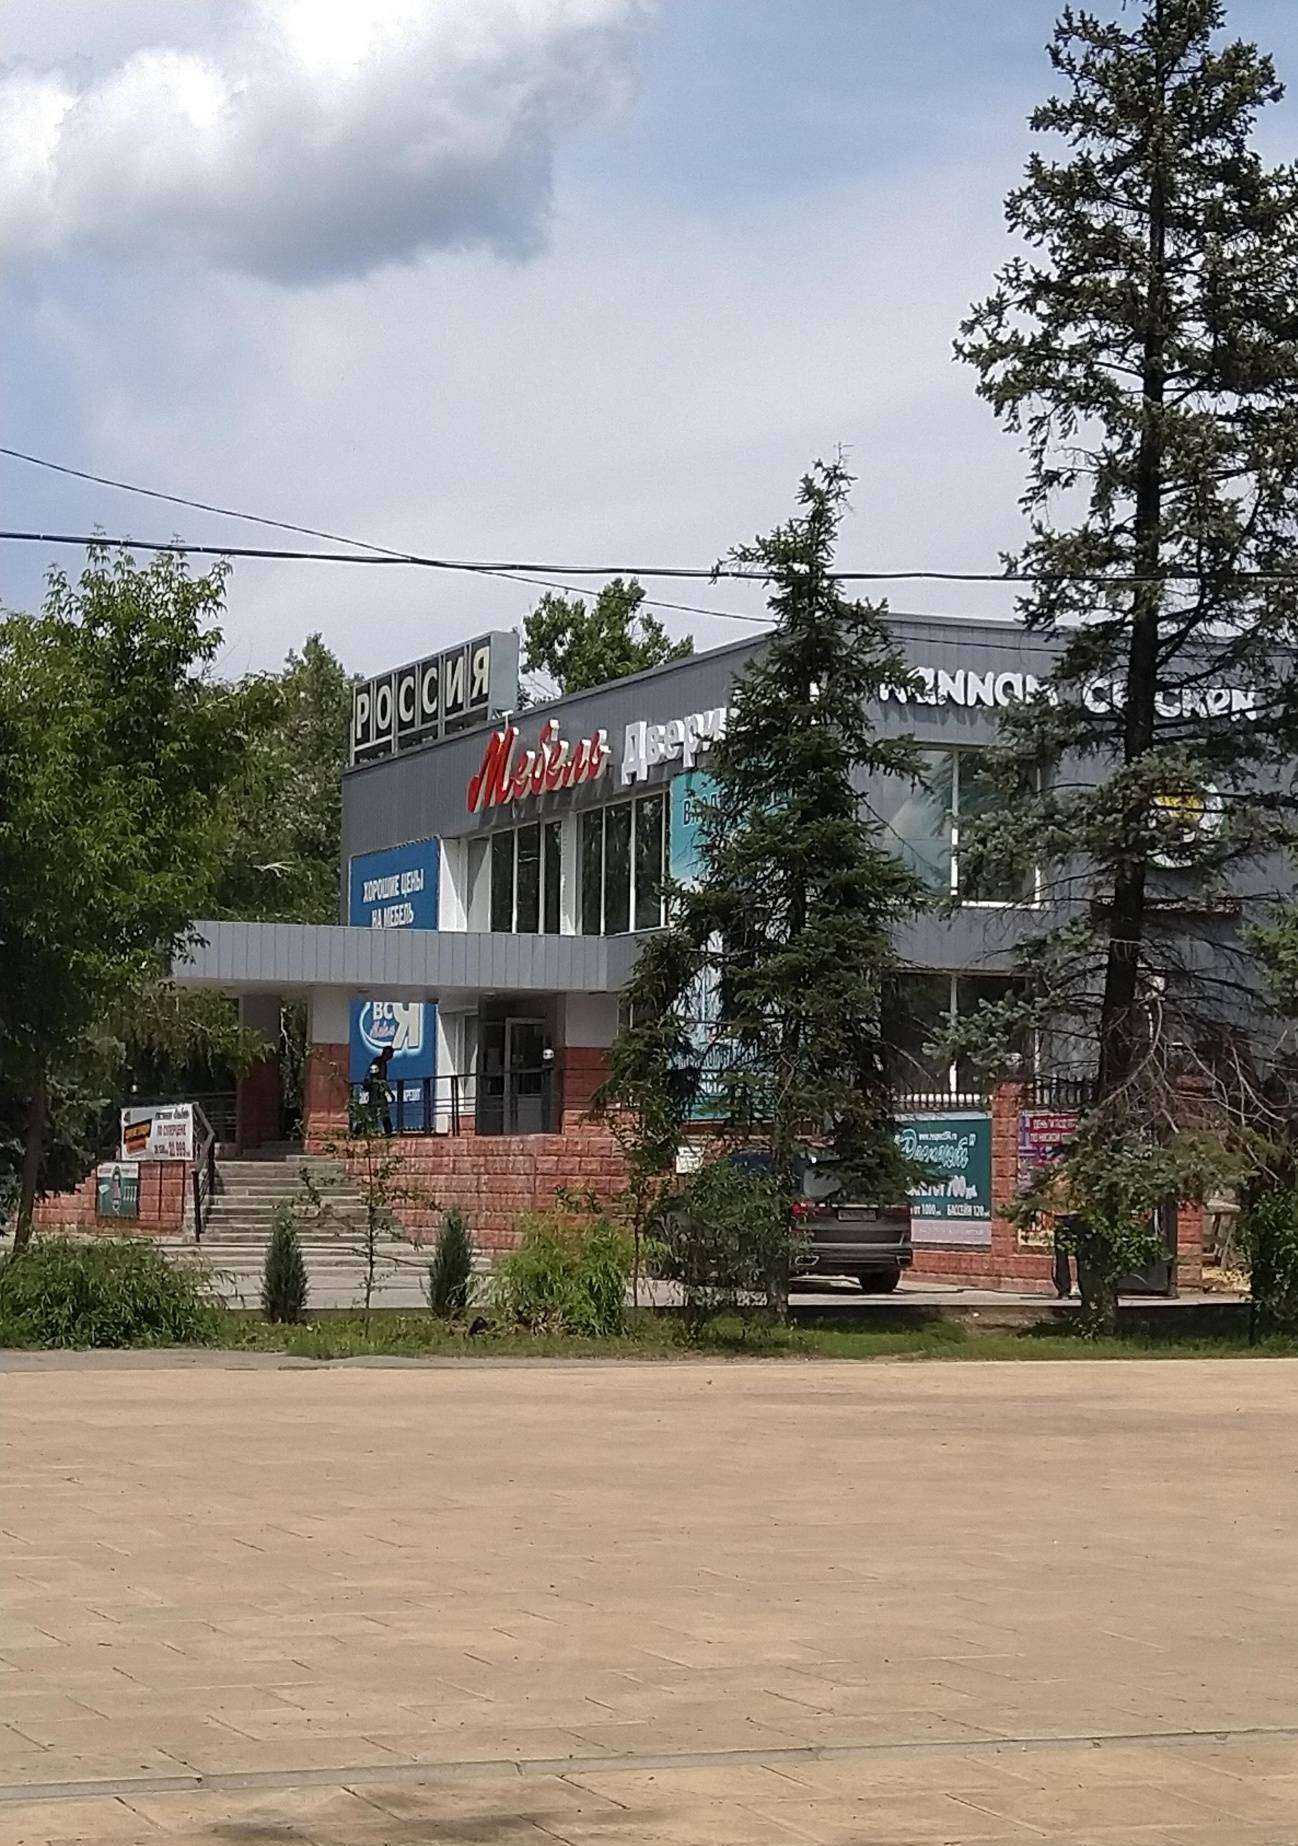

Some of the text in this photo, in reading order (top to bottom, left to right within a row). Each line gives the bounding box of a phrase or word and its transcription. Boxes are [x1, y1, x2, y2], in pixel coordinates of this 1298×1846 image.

[356, 645, 490, 740] РОССИЯ
[466, 719, 612, 813] Мебель
[363, 868, 424, 903] ХОРОШИЕ ЦЕНЫ
[371, 902, 414, 929] НА МЕБЕЛЬ
